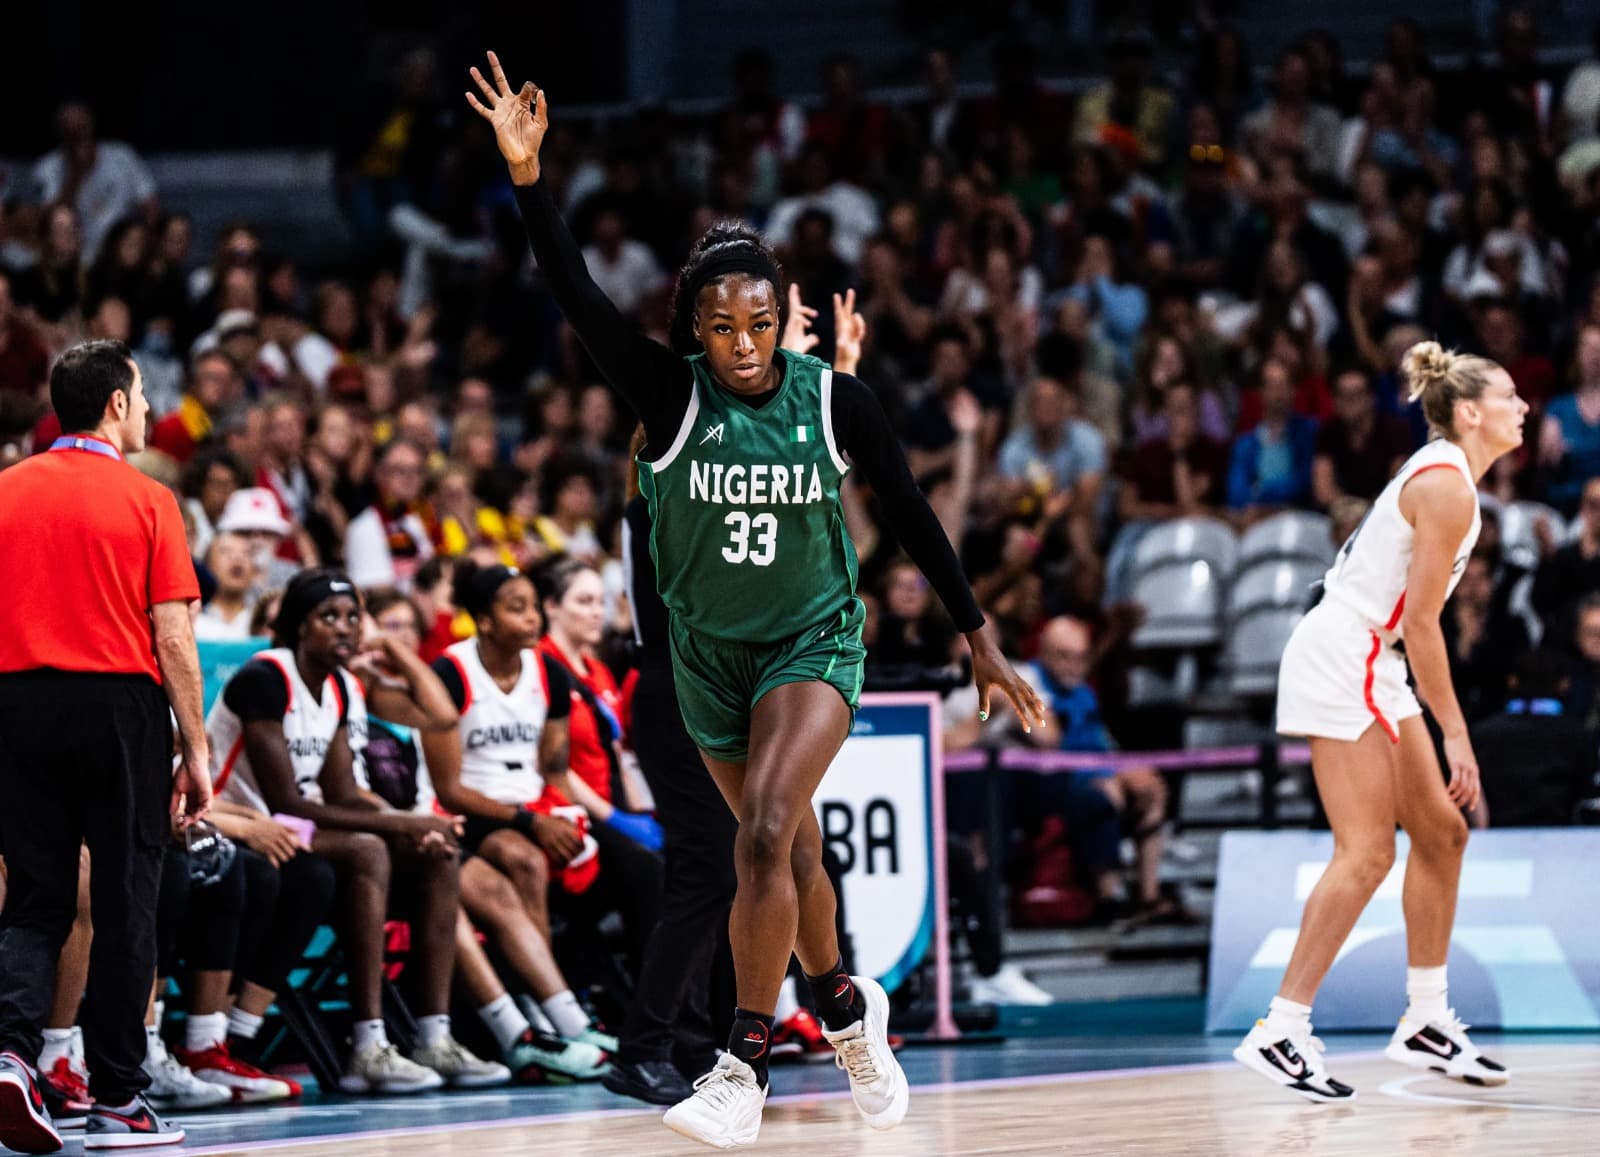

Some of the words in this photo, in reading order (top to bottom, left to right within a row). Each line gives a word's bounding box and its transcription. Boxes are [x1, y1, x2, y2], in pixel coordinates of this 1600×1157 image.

[689, 460, 823, 504] NIGERIA
[721, 511, 778, 566] 33
[467, 722, 539, 750] CANAD
